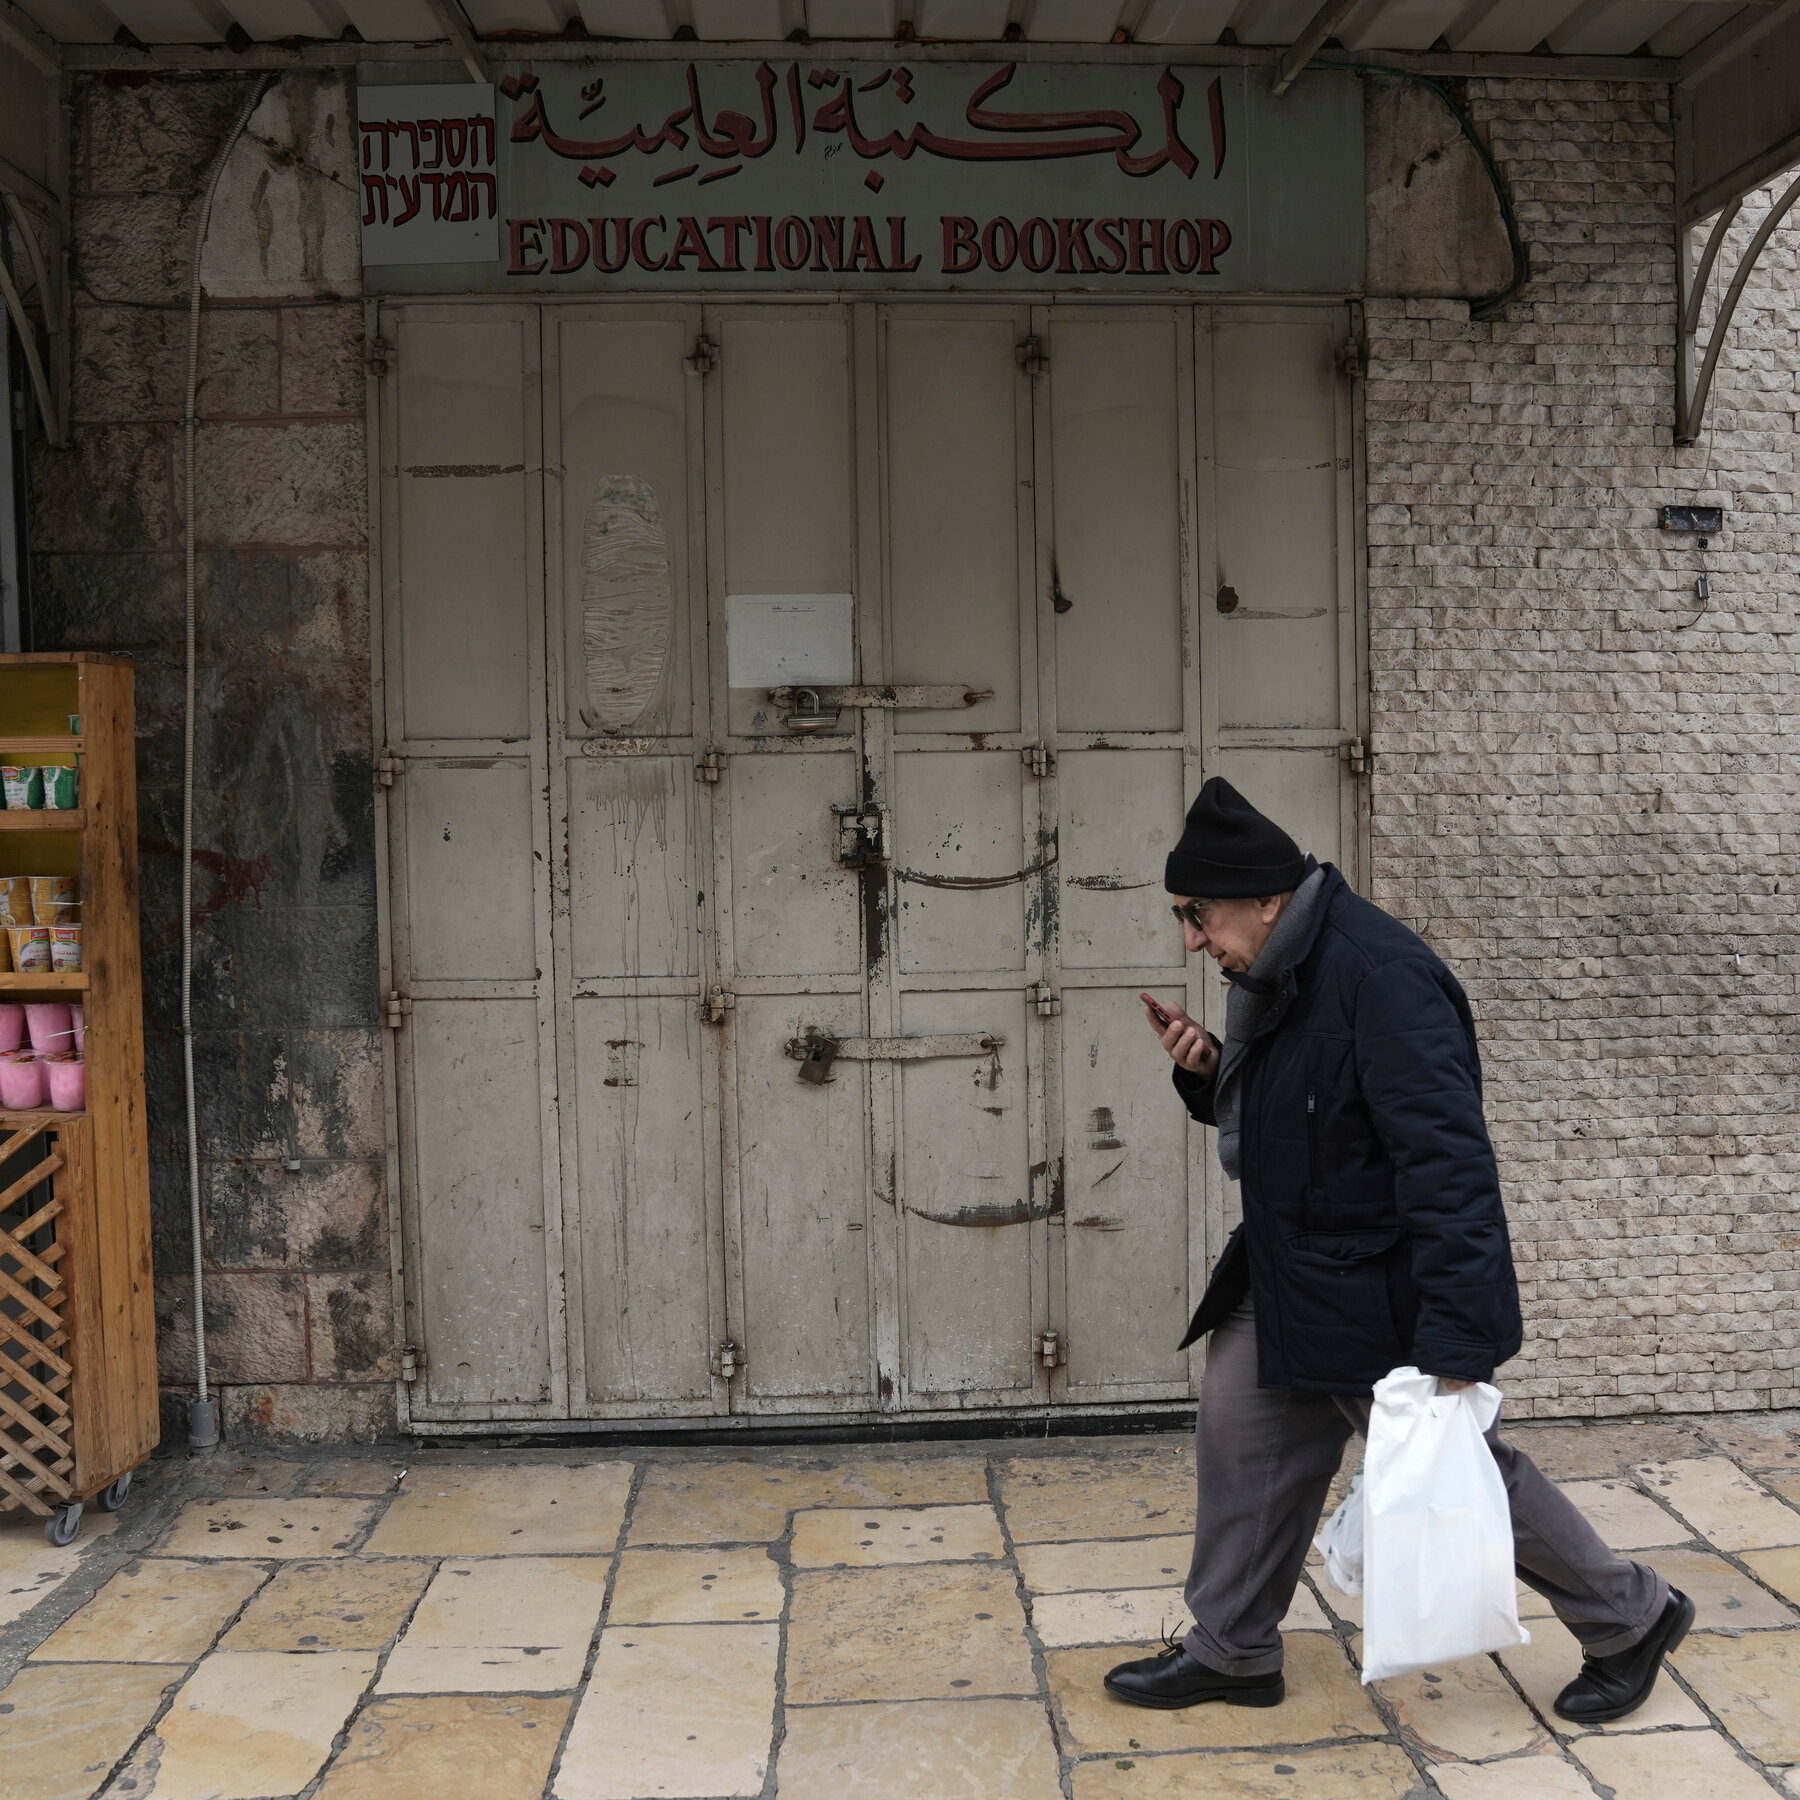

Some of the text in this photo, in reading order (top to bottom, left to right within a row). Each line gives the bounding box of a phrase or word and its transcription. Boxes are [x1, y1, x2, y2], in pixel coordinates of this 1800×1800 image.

[359, 116, 497, 172] הספריה
[361, 171, 498, 228] המדעית
[507, 215, 1232, 276] EDUCATIONAL BOOKSHOP
